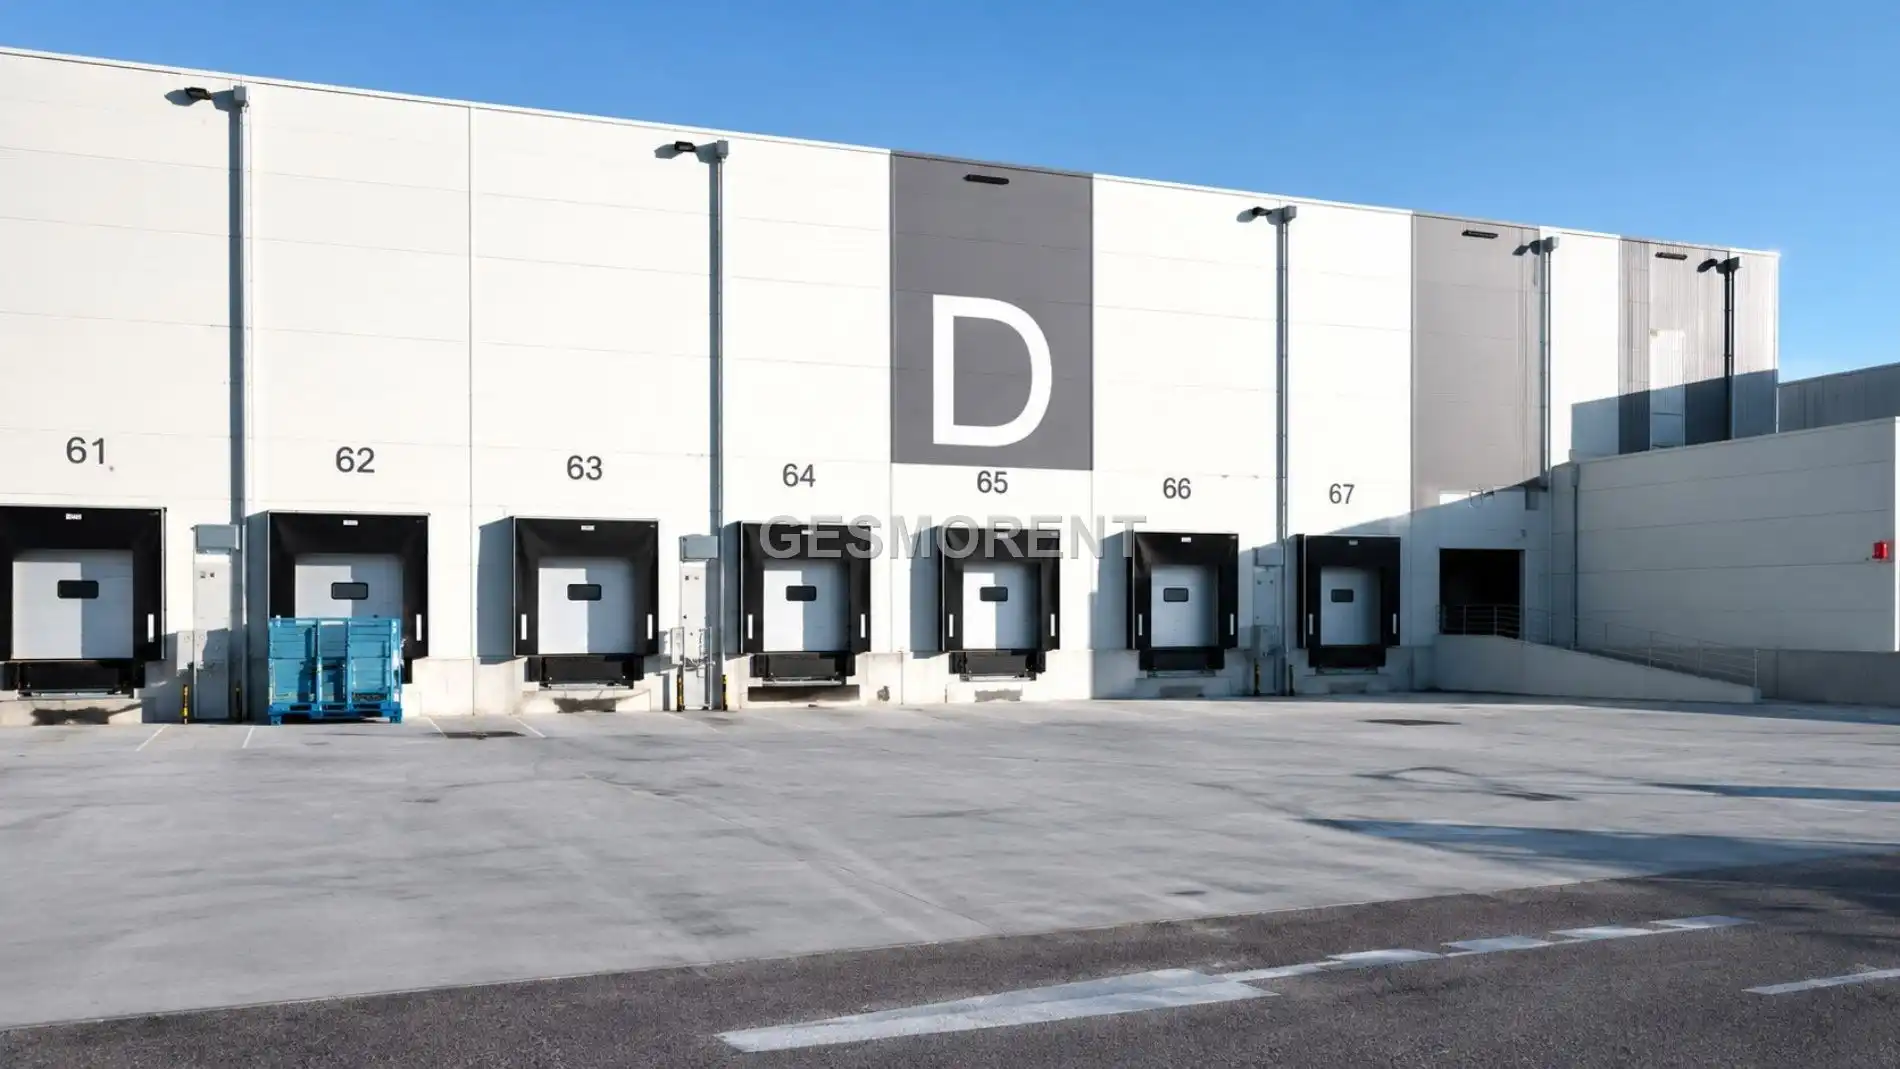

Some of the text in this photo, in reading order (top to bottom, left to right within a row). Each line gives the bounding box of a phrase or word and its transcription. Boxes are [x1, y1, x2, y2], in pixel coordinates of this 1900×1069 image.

[932, 294, 1053, 447] D
[66, 436, 106, 465] 61
[335, 446, 375, 474] 62
[566, 454, 603, 481] 63
[782, 463, 816, 488] 64
[976, 471, 1008, 494] 65
[1163, 477, 1192, 500] 66
[1329, 483, 1355, 505] 67
